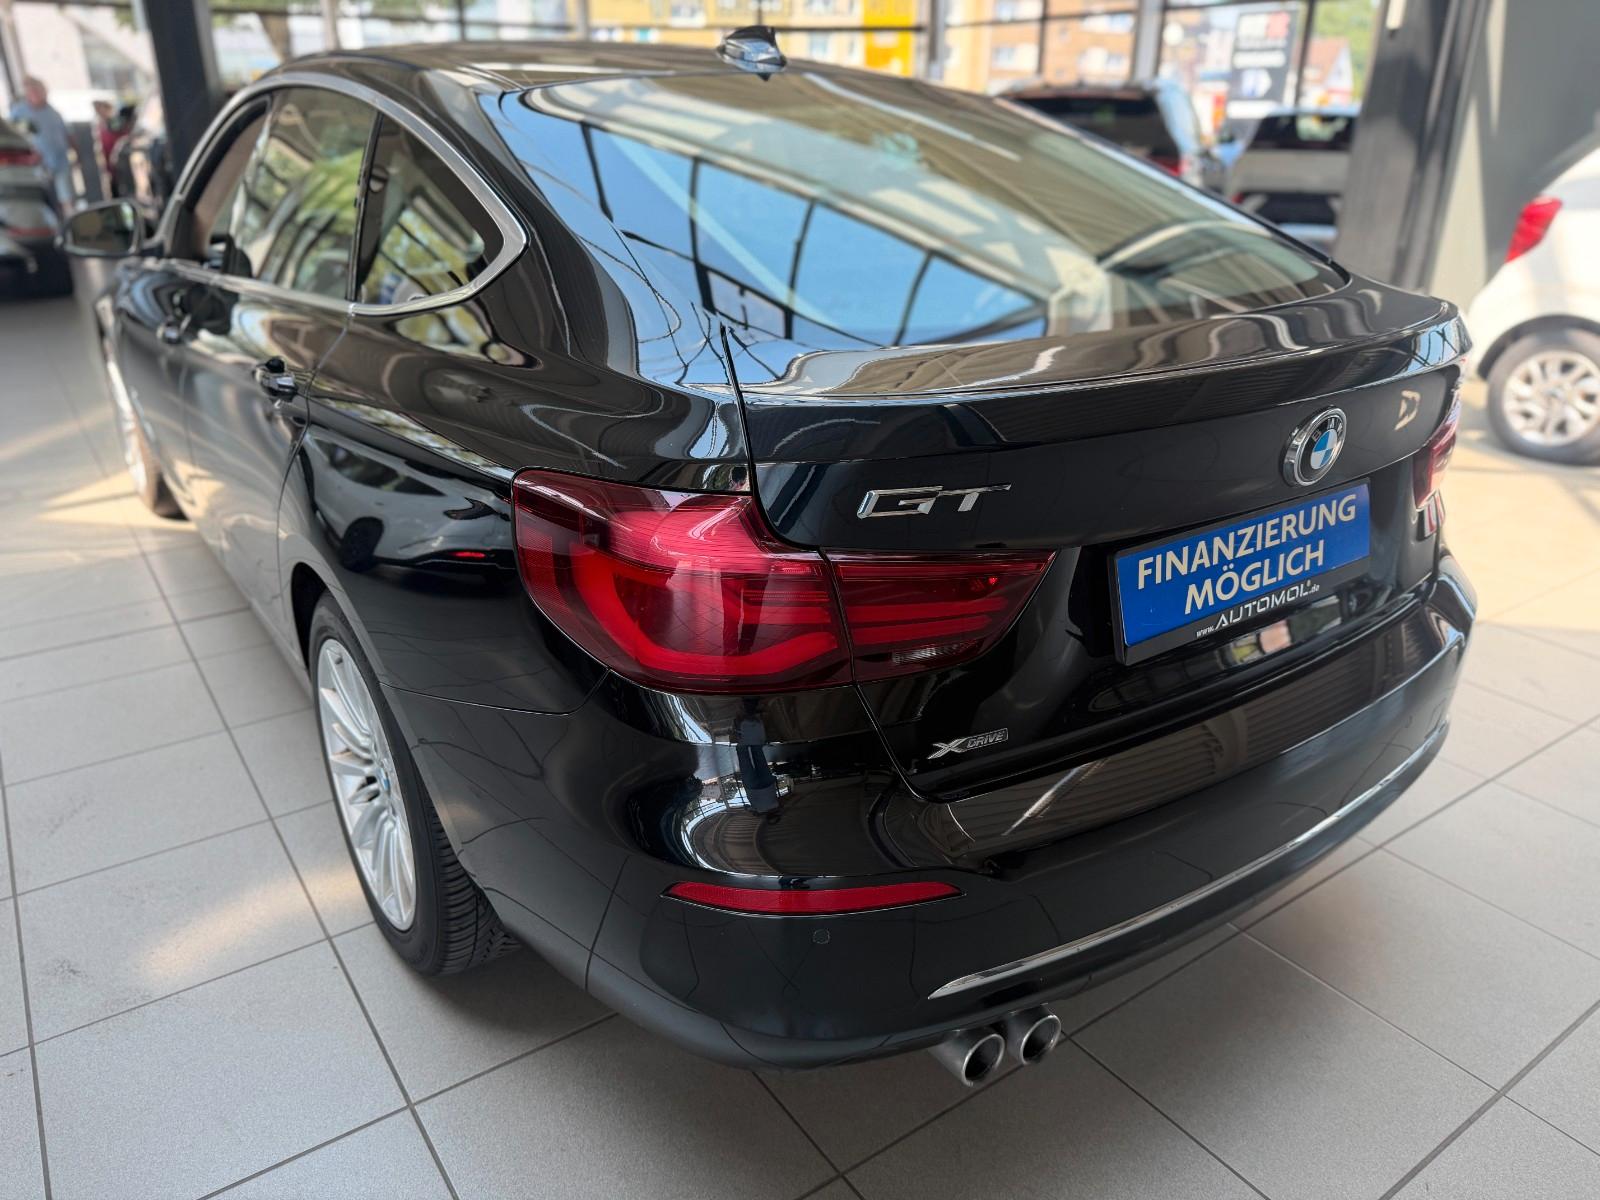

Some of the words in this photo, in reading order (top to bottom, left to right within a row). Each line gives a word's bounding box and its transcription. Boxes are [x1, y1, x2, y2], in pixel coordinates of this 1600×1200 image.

[857, 484, 1011, 519] GT
[1137, 494, 1357, 590] FINANZIERUNG
[1184, 539, 1325, 615] MÖGLICH
